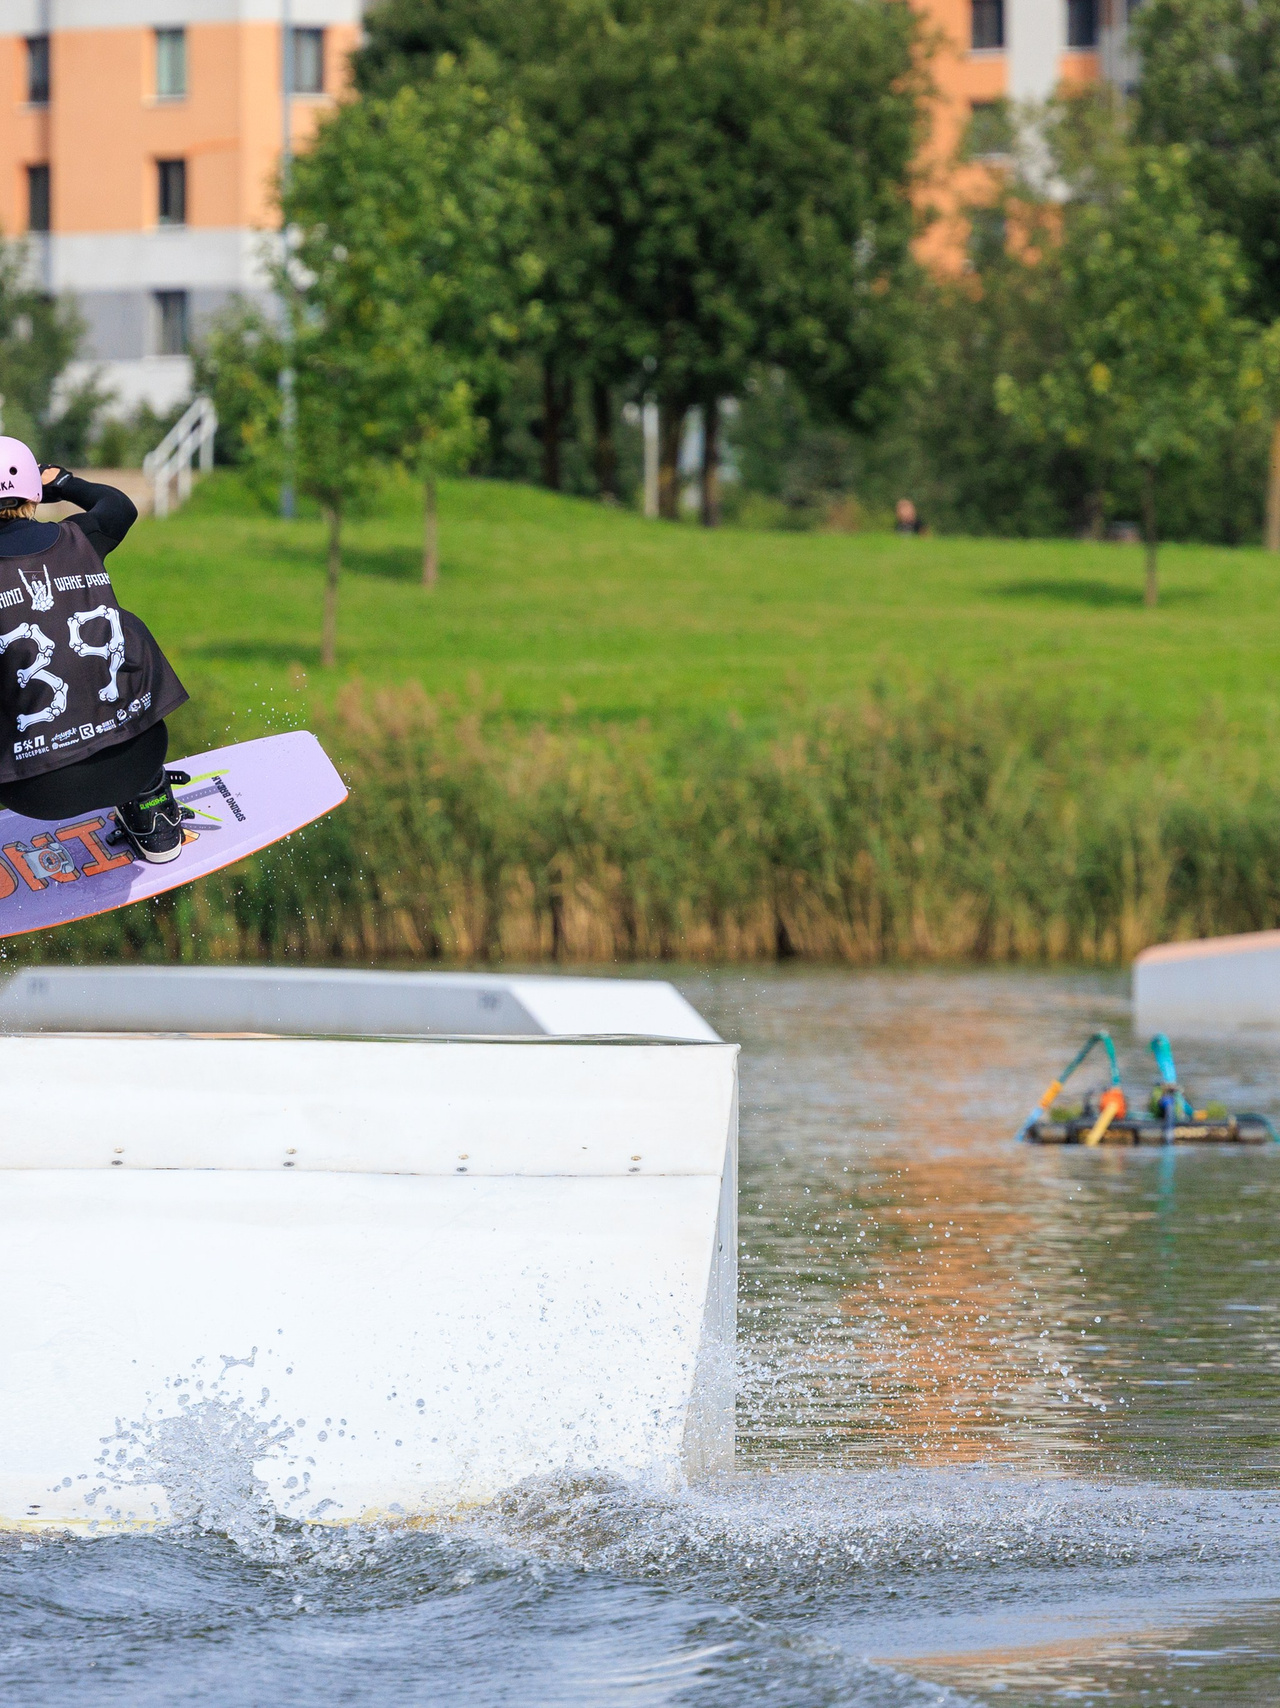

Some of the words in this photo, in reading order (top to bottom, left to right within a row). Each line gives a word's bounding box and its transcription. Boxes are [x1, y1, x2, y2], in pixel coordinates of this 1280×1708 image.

[53, 574, 86, 592] WAKE
[15, 746, 50, 761] АВТОСЕРВИС
[211, 775, 231, 798] BREAK
[226, 797, 246, 822] SPRING
